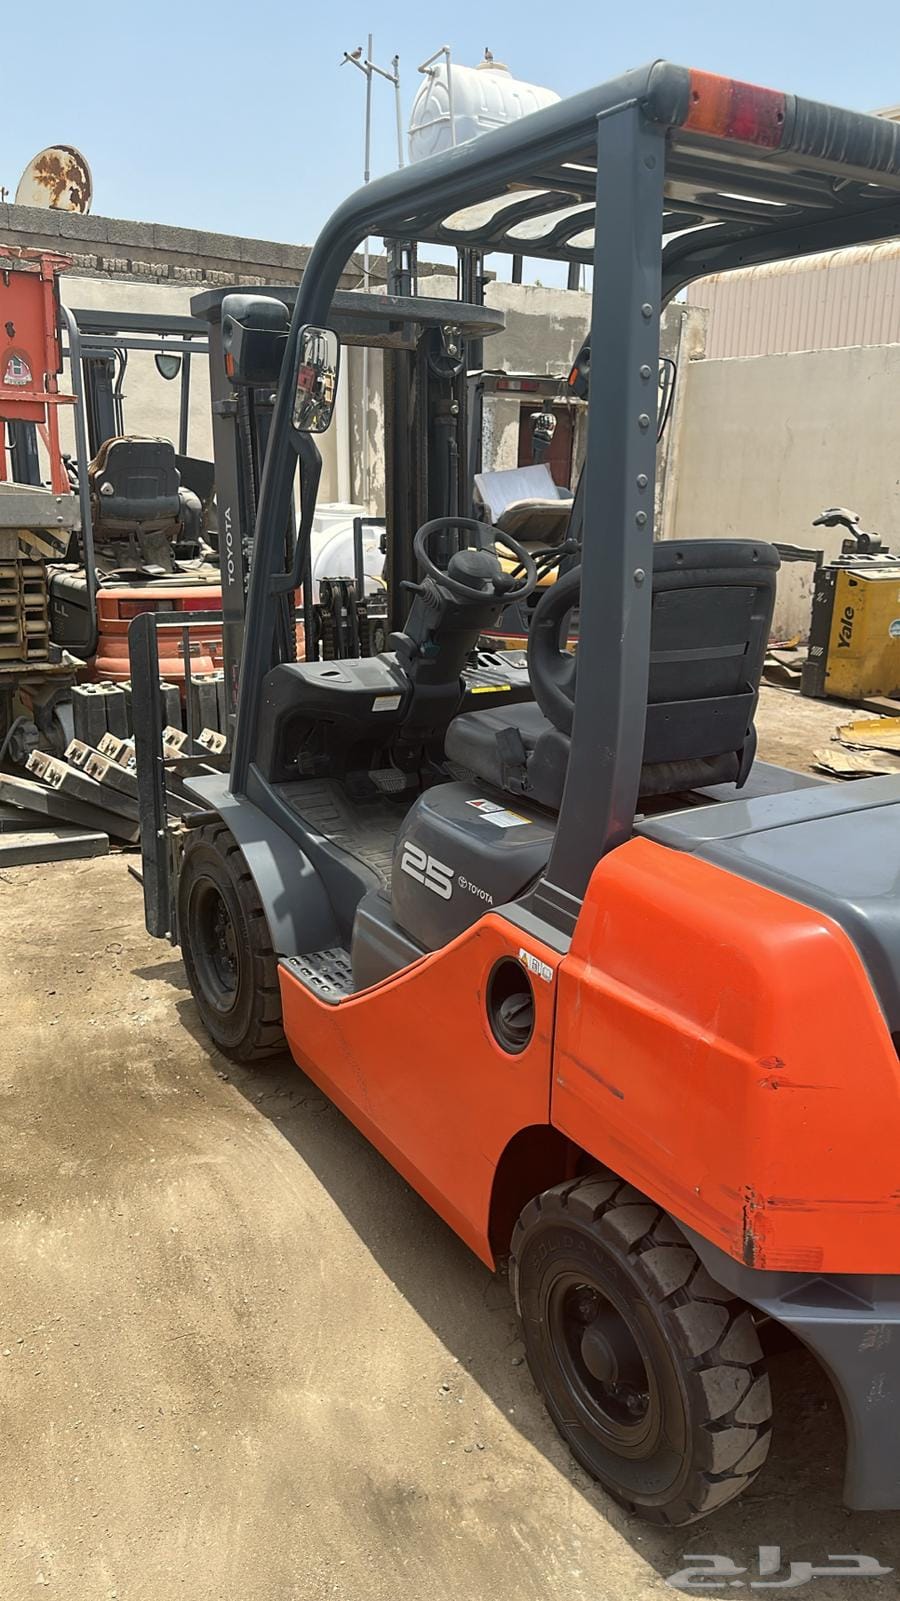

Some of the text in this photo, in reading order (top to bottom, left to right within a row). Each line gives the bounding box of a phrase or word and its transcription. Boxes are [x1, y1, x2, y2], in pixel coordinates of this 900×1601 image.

[225, 507, 235, 586] TOYOTA
[838, 606, 855, 648] Yale
[401, 841, 455, 900] 25
[467, 882, 494, 905] TOYOTA
